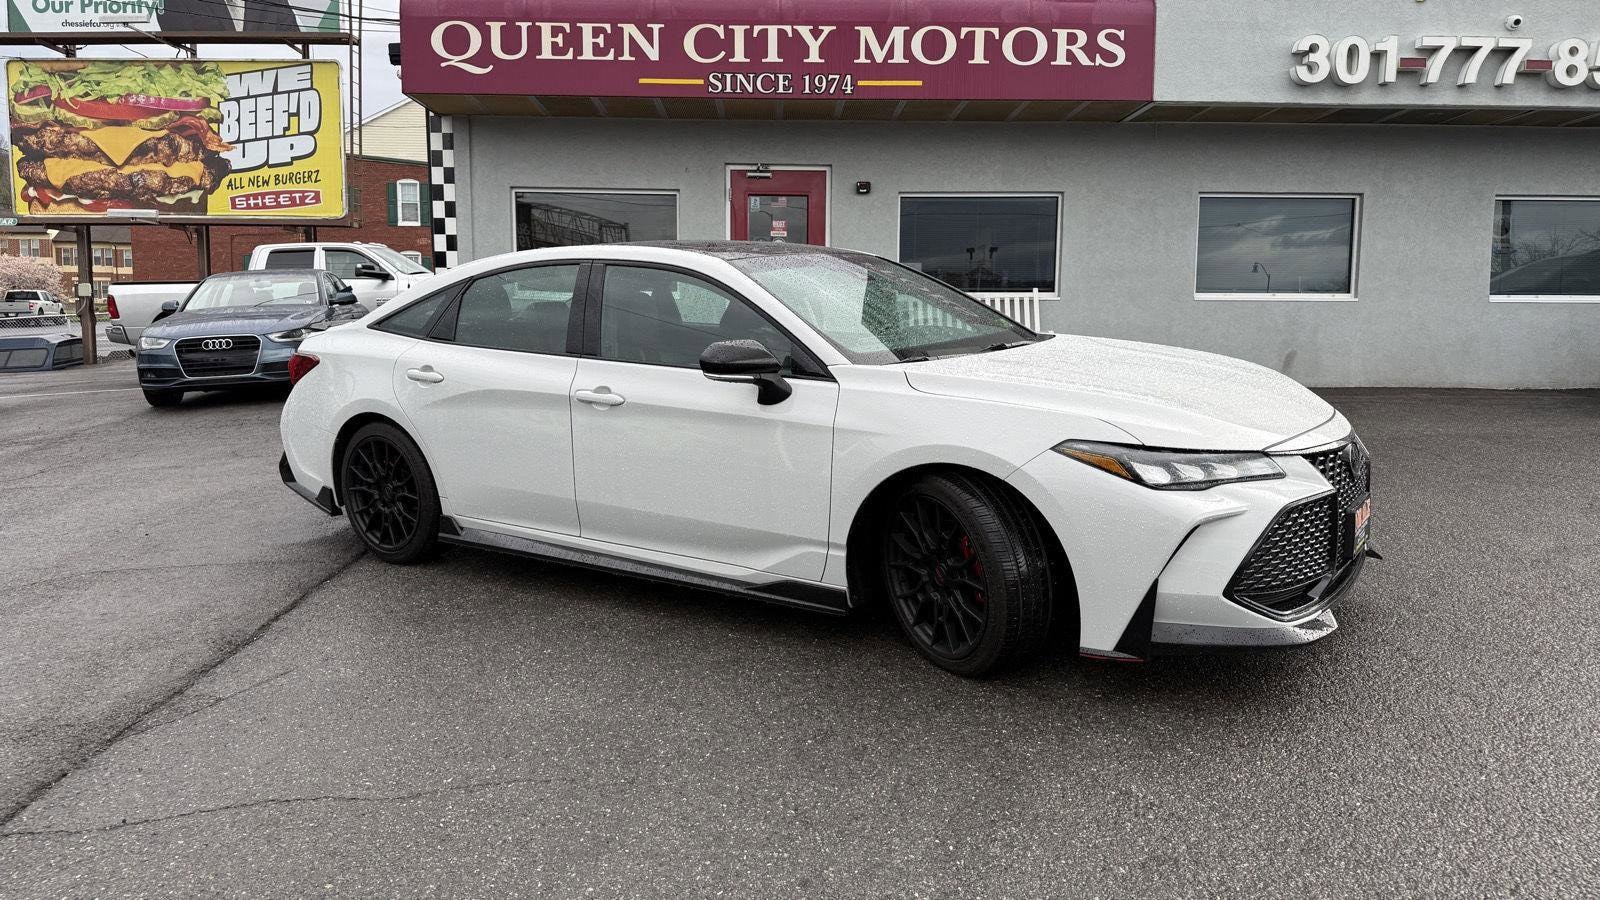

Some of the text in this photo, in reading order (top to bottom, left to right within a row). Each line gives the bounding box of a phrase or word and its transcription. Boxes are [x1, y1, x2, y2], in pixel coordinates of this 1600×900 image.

[31, 0, 165, 17] Our Priority!
[61, 19, 115, 30] chessiefcu.org
[430, 20, 1127, 75] QUEEN CITY MOTORS
[1289, 33, 1600, 89] 301-777-8
[226, 64, 313, 99] WE
[707, 72, 854, 95] SINCE 1974
[219, 89, 321, 144] BEEF'D
[221, 134, 316, 171] UP
[226, 169, 322, 191] ALL NEW BURGERZ
[235, 192, 316, 209] SHEETZ
